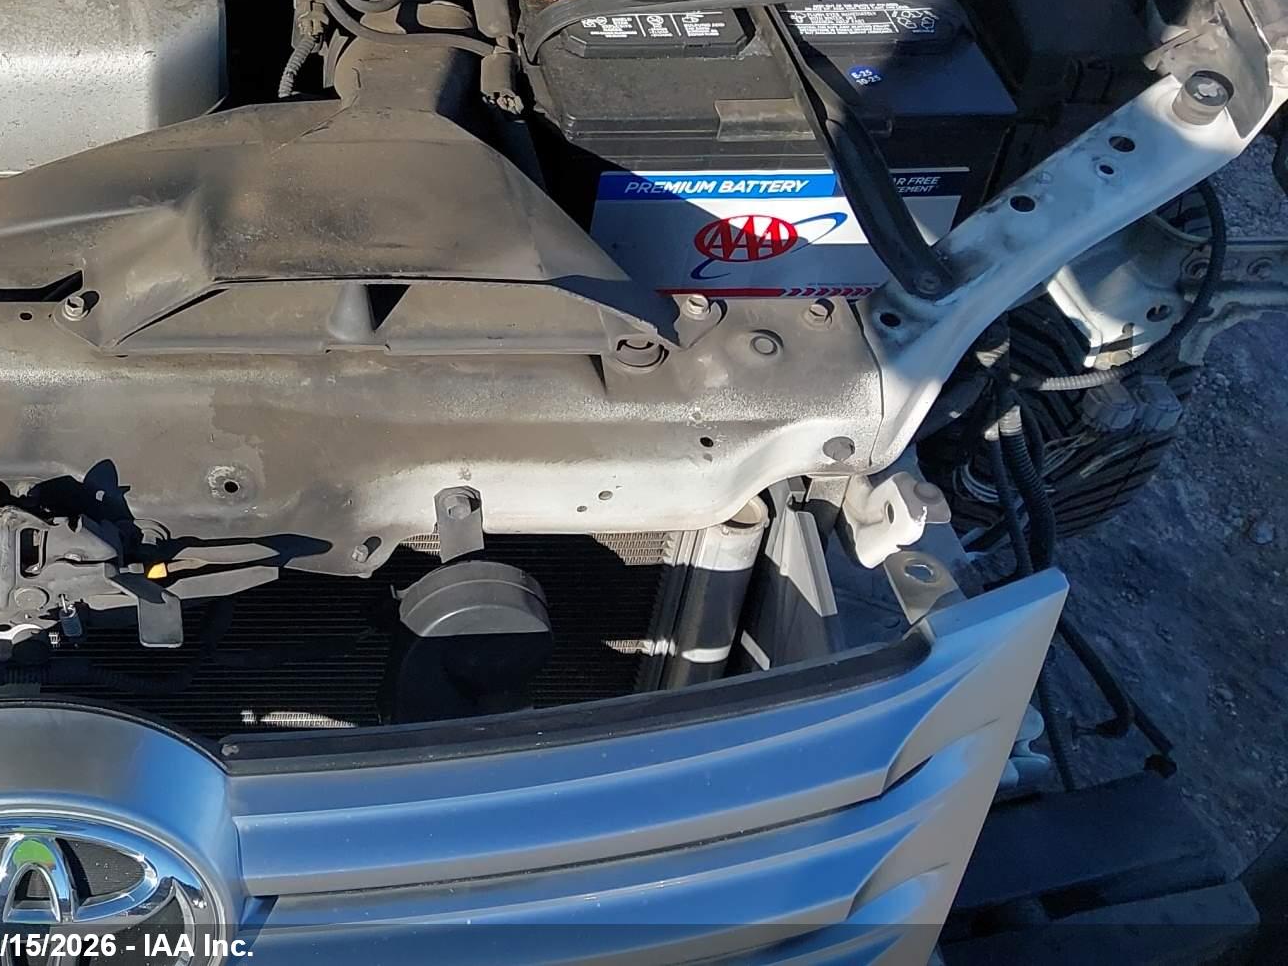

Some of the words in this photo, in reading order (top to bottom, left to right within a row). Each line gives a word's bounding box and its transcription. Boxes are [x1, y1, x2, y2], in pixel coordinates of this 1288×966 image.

[624, 180, 717, 194] PREMIUM
[718, 180, 809, 194] BATTERY
[906, 177, 941, 186] FREE
[698, 215, 792, 261] AAA
